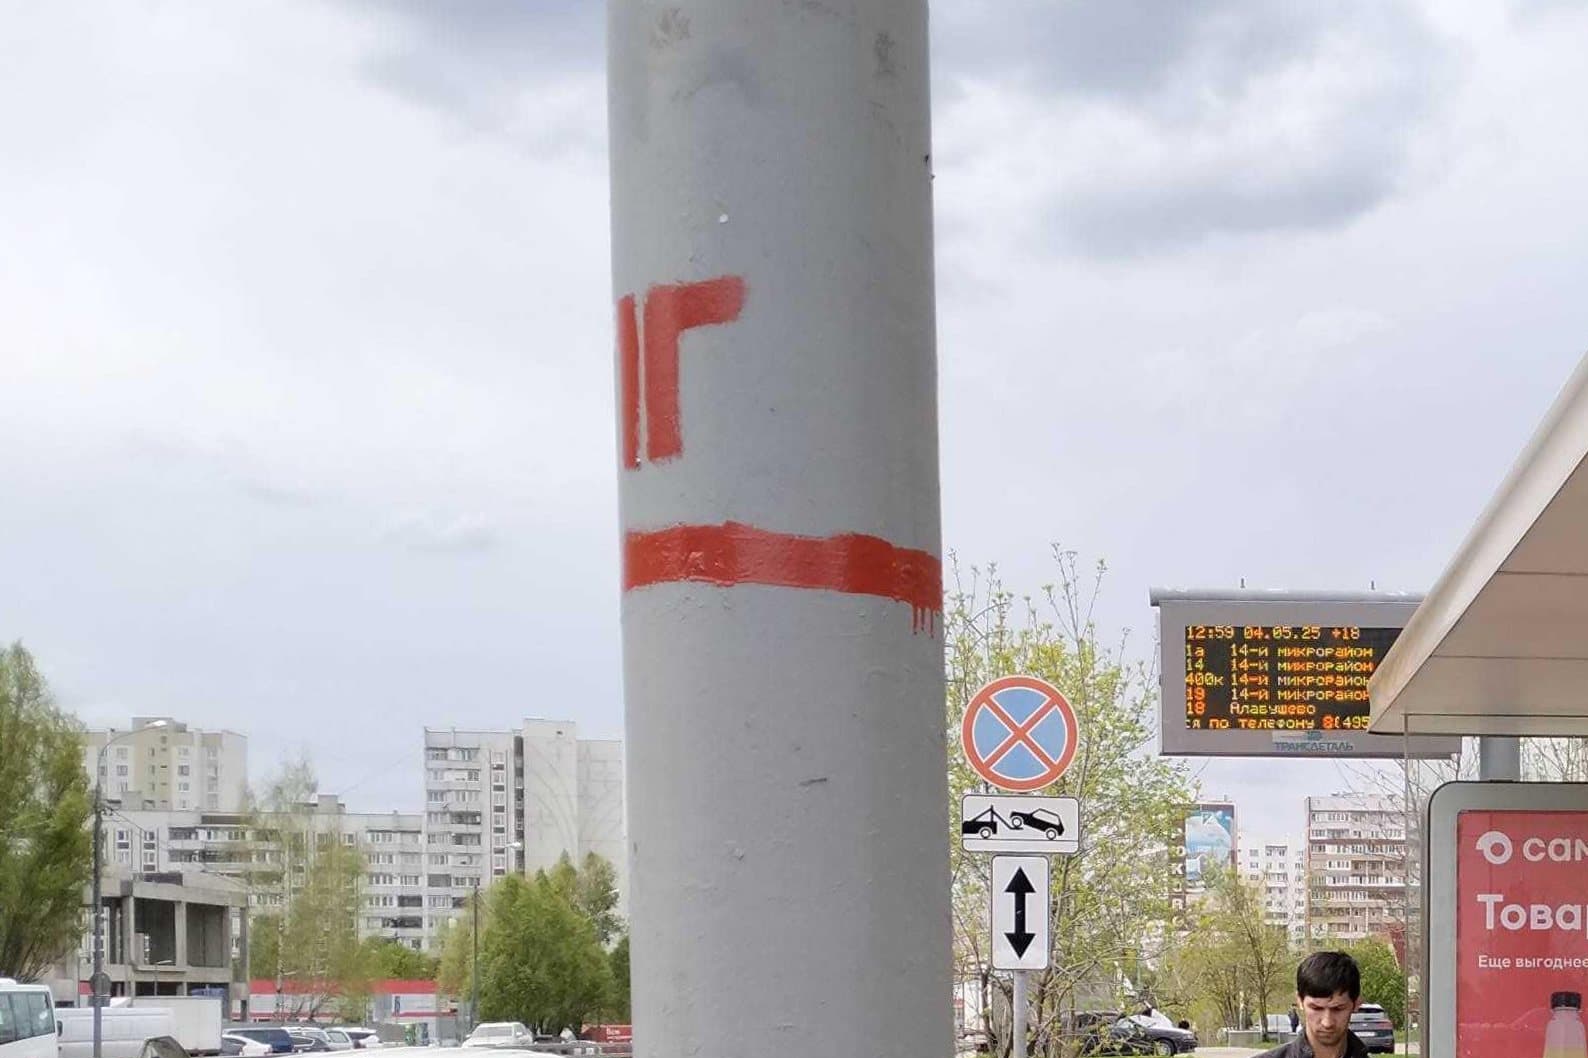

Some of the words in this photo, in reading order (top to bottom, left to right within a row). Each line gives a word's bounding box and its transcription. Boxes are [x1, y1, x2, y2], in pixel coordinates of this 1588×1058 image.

[1186, 625, 1235, 640] 12:59
[1243, 625, 1321, 640] 04.05.25
[1331, 625, 1361, 640] +18
[1230, 643, 1269, 657] 14-й
[1277, 646, 1374, 657] микрорайон
[1186, 658, 1205, 671] 14
[1230, 658, 1269, 671] 14-й
[1277, 660, 1375, 671] микрорайон
[1185, 674, 1224, 686] 400к
[1230, 673, 1269, 686] 14-й
[1230, 688, 1269, 700] 14-й
[1186, 702, 1206, 715] 18
[1230, 702, 1317, 715] Алабушево
[1209, 719, 1230, 729] по
[1238, 718, 1315, 730] телефону
[1477, 955, 1511, 971] Еще
